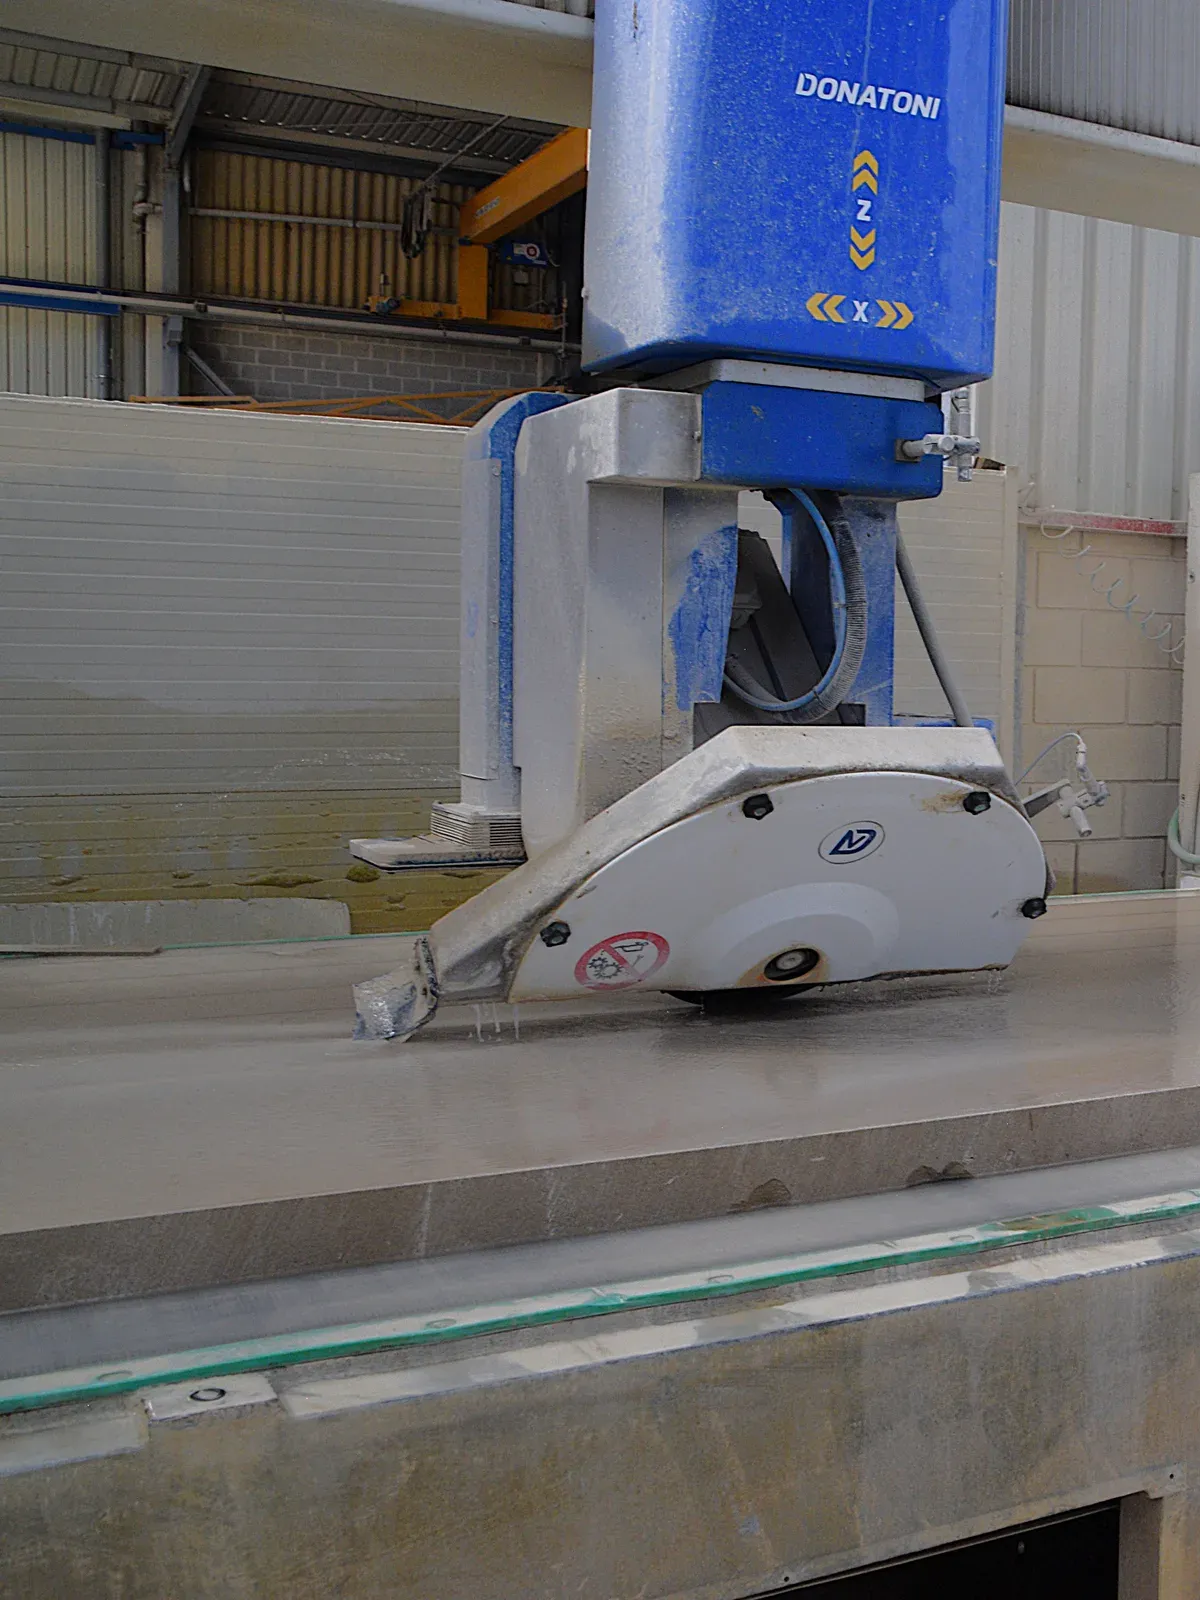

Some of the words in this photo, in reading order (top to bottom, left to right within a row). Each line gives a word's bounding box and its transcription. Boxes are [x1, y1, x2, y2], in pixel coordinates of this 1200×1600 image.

[795, 72, 941, 119] DONATONI
[856, 199, 872, 221] Z
[852, 300, 869, 322] X
